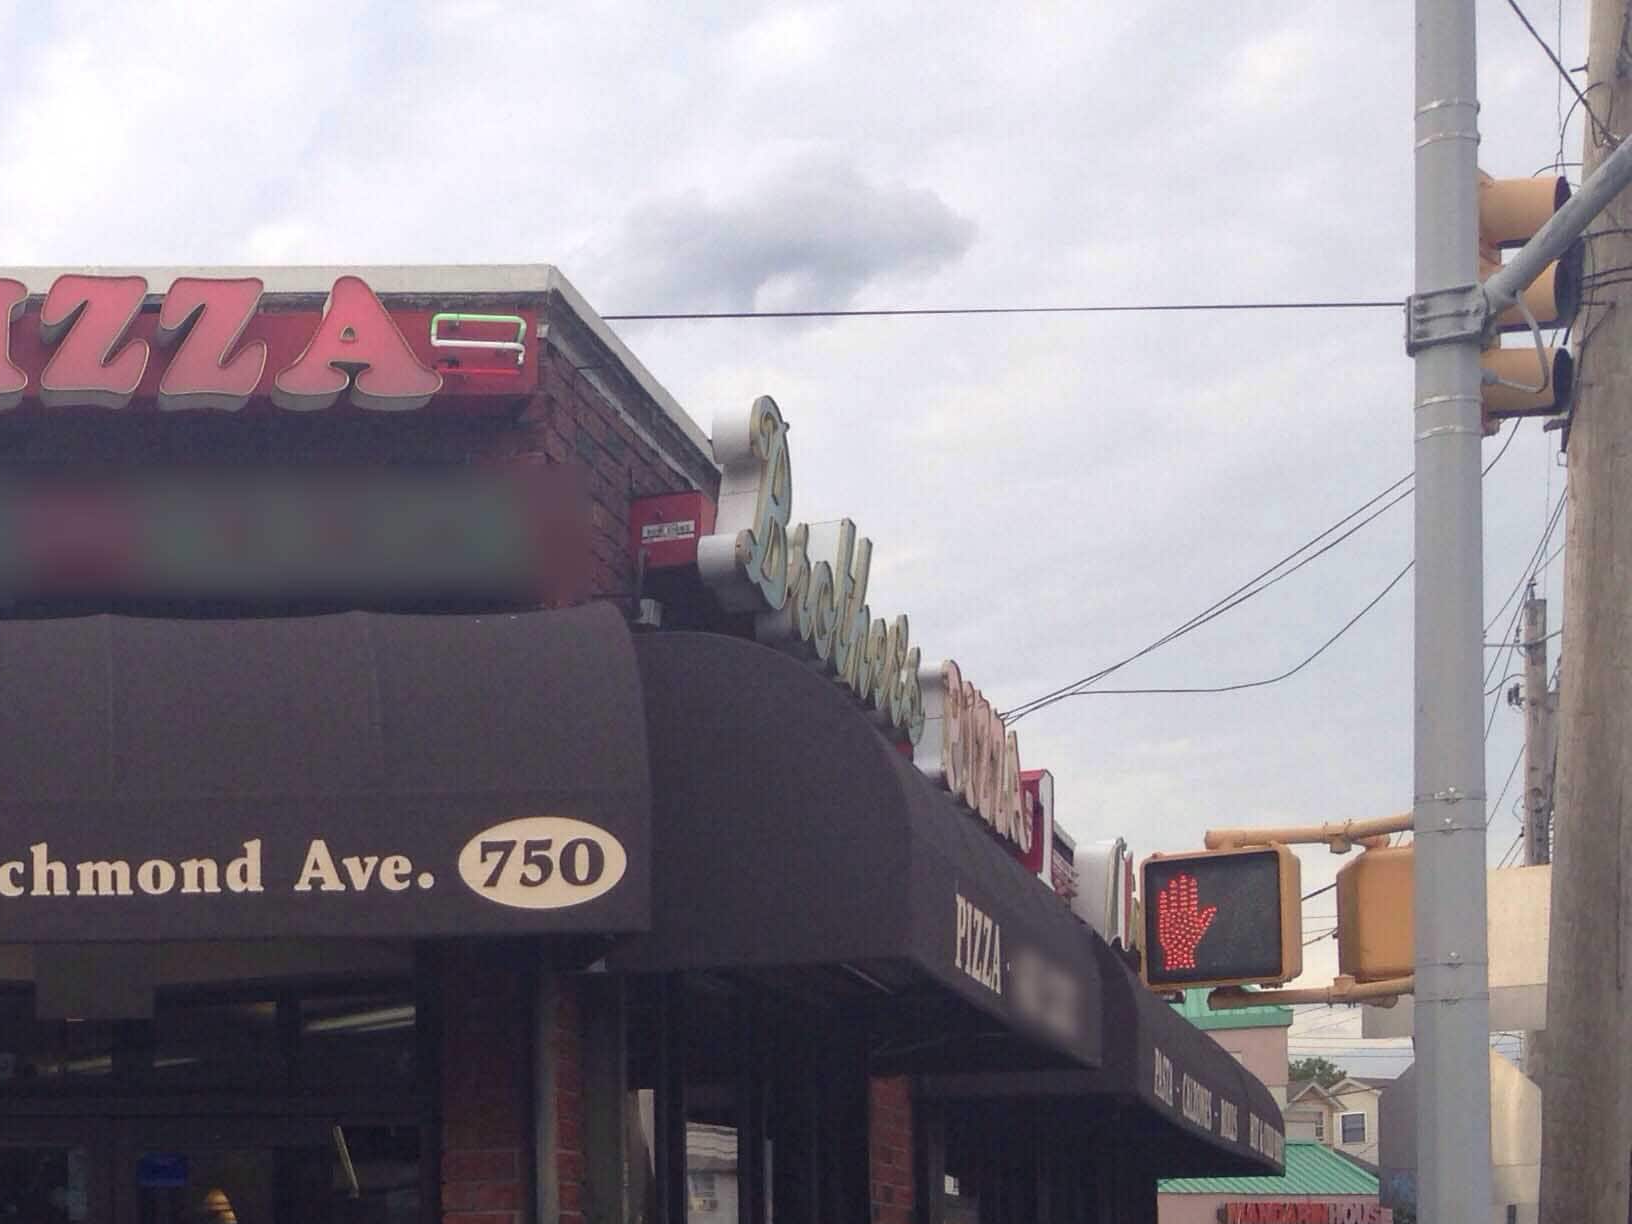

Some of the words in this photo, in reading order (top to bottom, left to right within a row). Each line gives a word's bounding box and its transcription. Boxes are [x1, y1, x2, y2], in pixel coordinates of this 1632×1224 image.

[294, 839, 435, 892] Ave.
[480, 837, 605, 888] 750
[955, 893, 1001, 995] PIZZA
